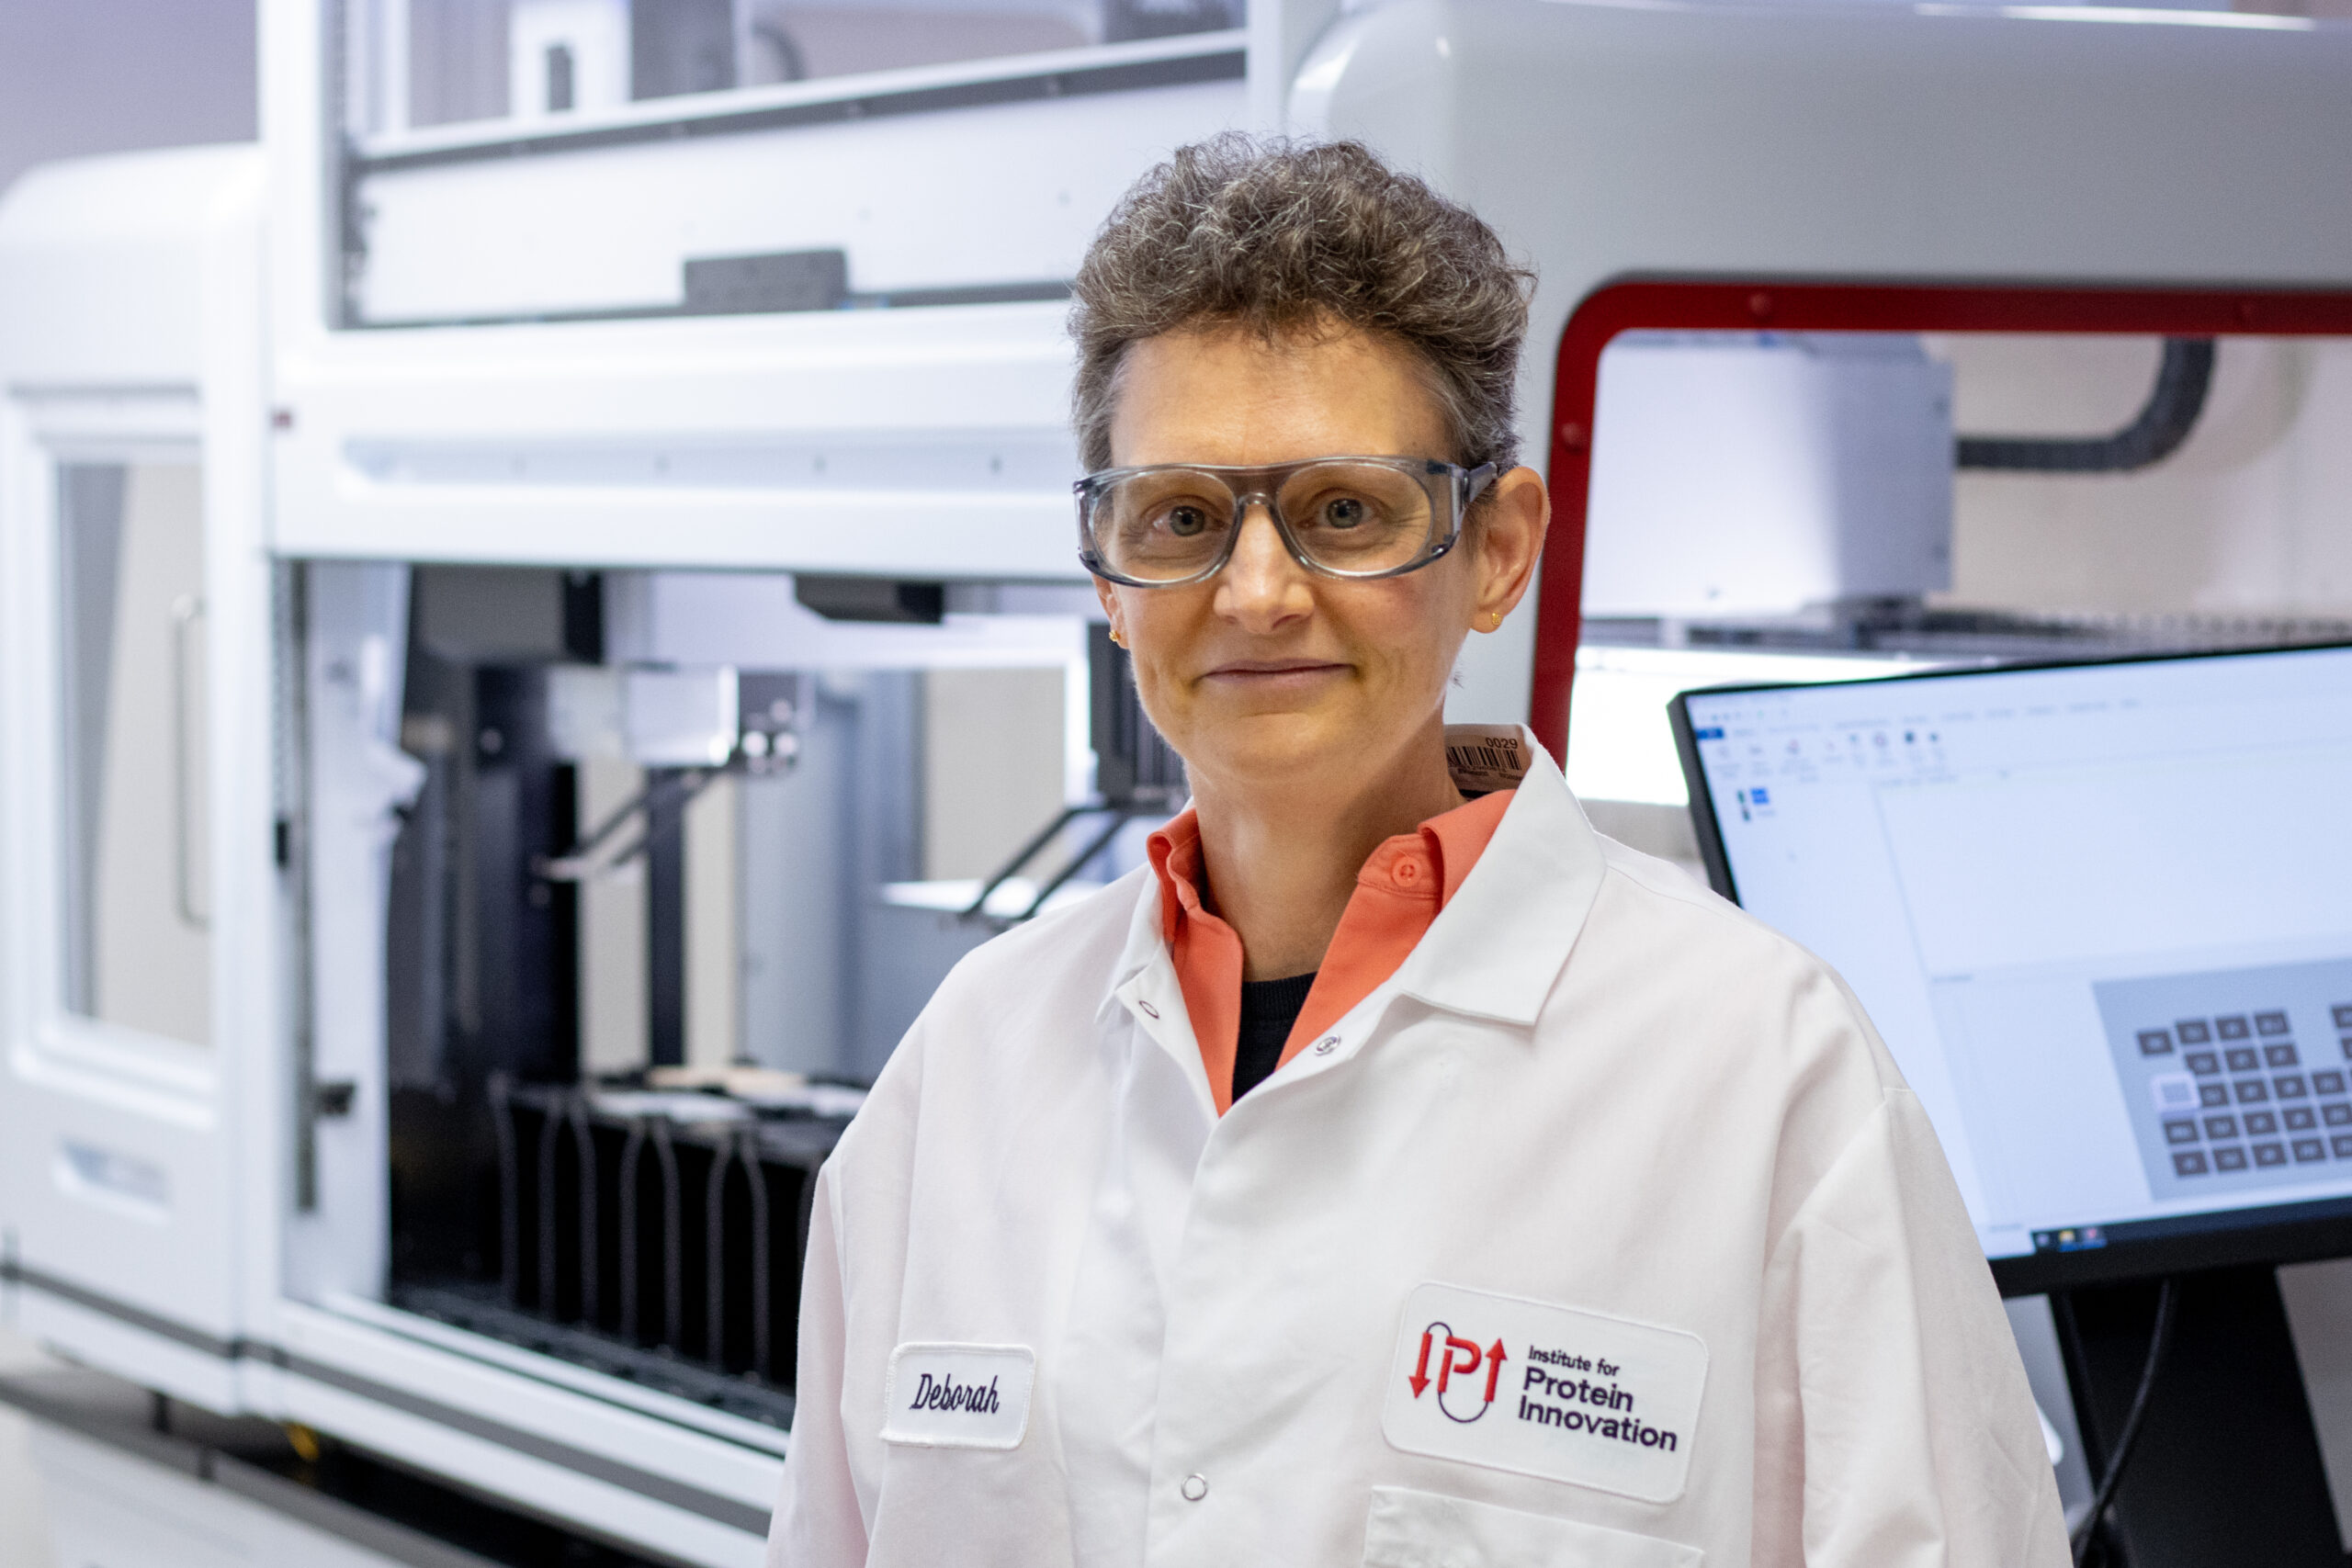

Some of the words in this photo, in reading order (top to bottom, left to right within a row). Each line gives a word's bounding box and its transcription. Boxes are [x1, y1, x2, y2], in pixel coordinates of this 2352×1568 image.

[1485, 737, 1518, 749] 0029
[1528, 1346, 1591, 1371] Institute
[1597, 1359, 1620, 1377] for
[910, 1373, 1000, 1414] Deborah
[1523, 1366, 1634, 1413] Protein
[1518, 1394, 1678, 1452] Innovation
